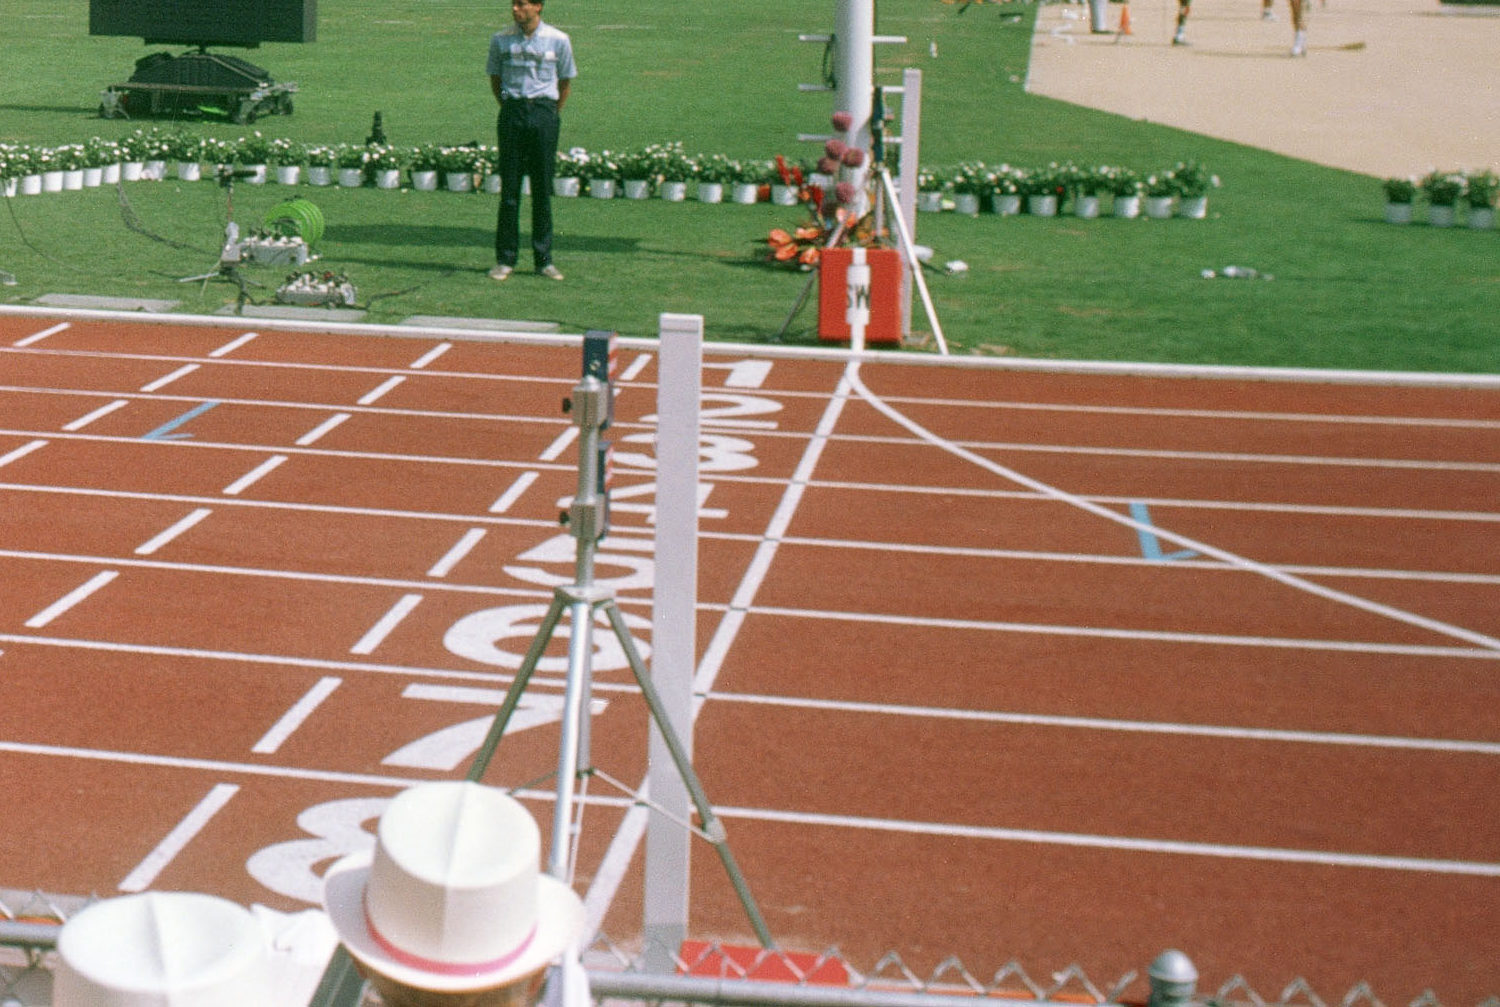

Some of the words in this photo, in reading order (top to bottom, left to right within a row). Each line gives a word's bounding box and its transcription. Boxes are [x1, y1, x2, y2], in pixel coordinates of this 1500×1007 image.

[639, 393, 784, 429] 2
[612, 433, 759, 472] 3
[556, 482, 729, 523] 4
[503, 534, 656, 590] 5
[443, 604, 654, 671] 6
[381, 683, 609, 770] 7
